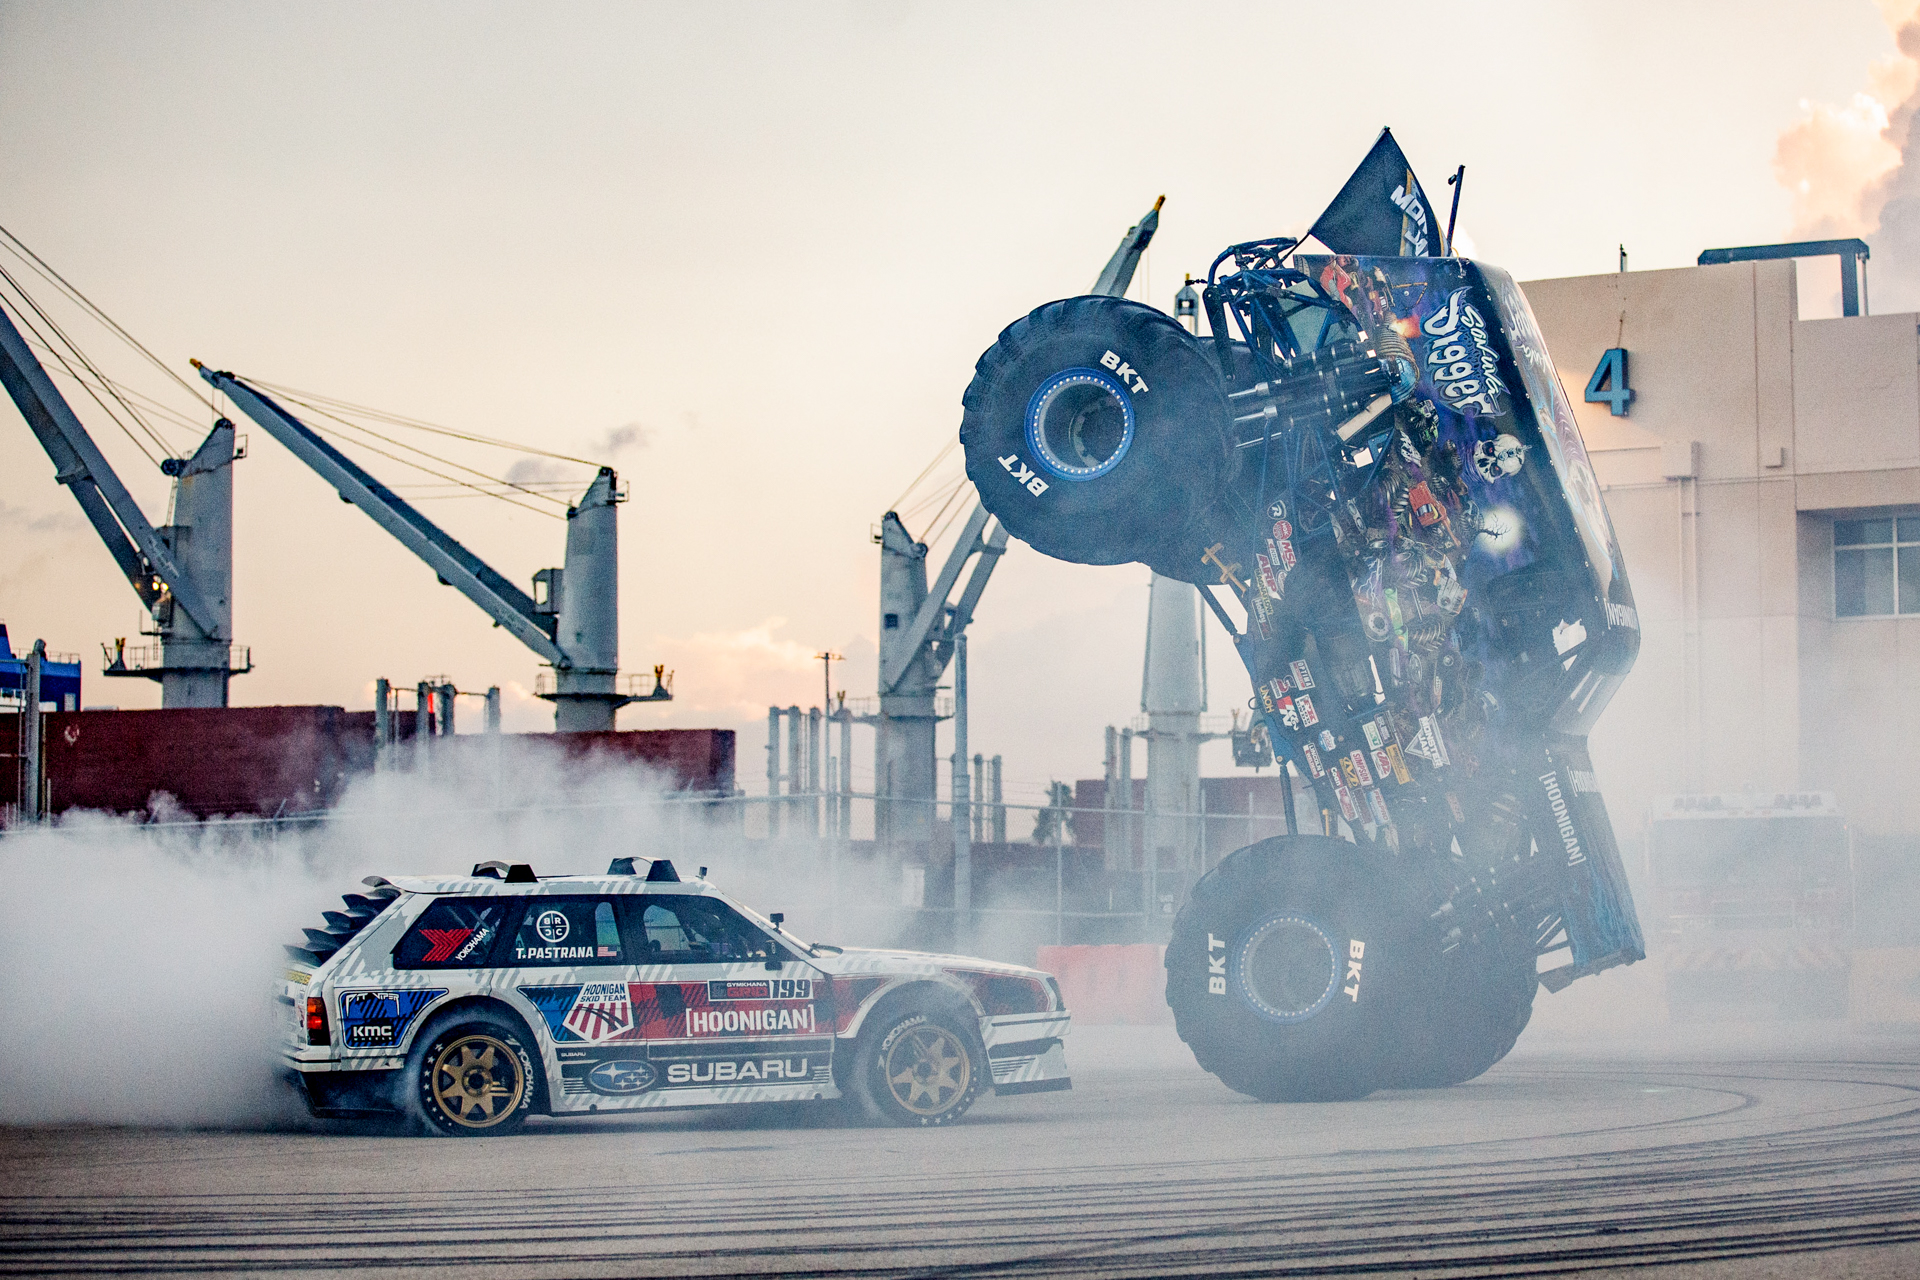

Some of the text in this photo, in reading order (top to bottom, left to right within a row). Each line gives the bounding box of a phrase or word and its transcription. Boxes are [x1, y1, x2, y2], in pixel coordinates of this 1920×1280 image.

[1404, 229, 1428, 257] JA
[1099, 349, 1149, 394] BKT
[1585, 347, 1631, 416] 4
[997, 453, 1050, 497] BKT
[1258, 555, 1277, 592] ARP
[1297, 662, 1312, 688] OPTIMA
[1260, 684, 1275, 713] UNOH
[1417, 734, 1432, 757] JAM
[1419, 716, 1443, 768] MONSTER
[1308, 743, 1322, 773] LINCOLN
[1353, 753, 1370, 782] SIMPSON
[455, 928, 490, 961] YOKOHAMA
[1208, 933, 1226, 995] BKT
[1343, 939, 1366, 1002] BKT
[583, 983, 626, 995] HOONIGAN
[726, 987, 769, 998] GRID
[770, 979, 813, 999] 199
[517, 1047, 534, 1109] YOKOHAMA
[667, 1058, 808, 1083] SUBARU
